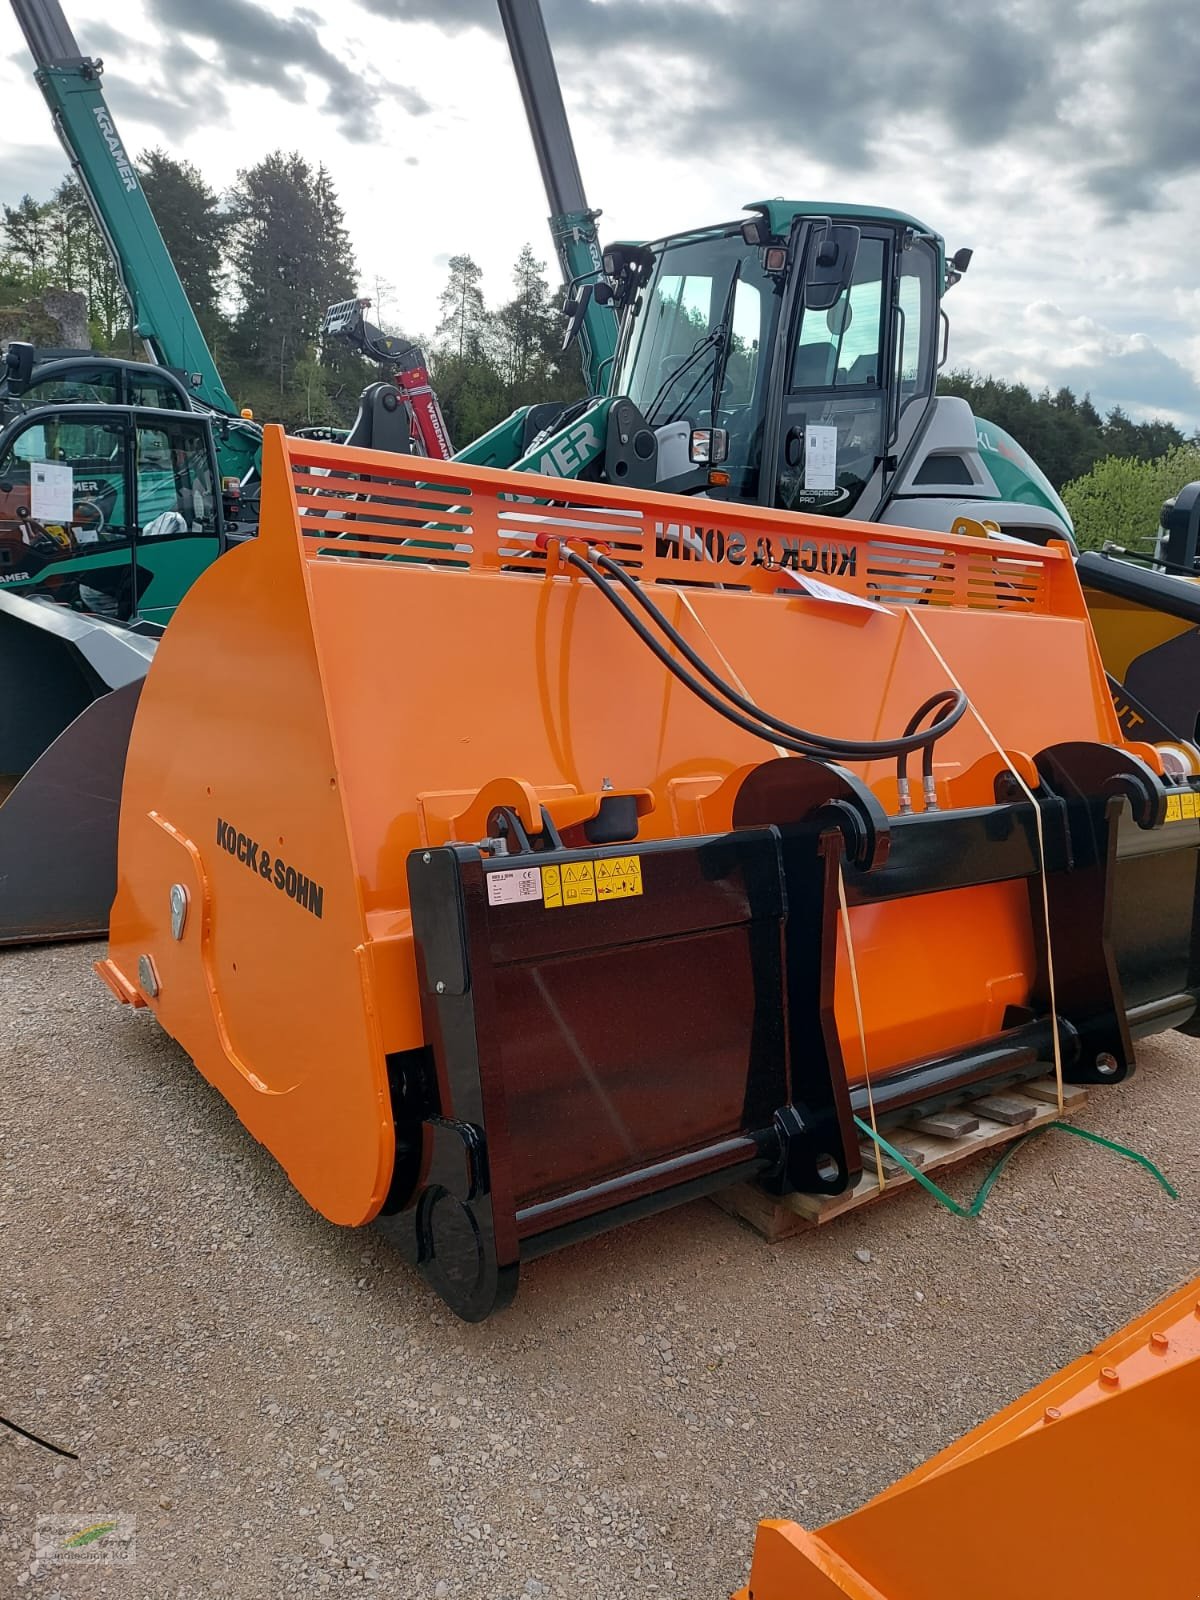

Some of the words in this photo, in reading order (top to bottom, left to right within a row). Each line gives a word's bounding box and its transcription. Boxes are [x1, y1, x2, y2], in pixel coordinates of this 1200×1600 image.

[93, 107, 137, 192] KRAMER
[800, 496, 816, 504] PRO
[216, 817, 259, 873] KOCK
[259, 850, 273, 883] &
[273, 858, 324, 919] SOHN
